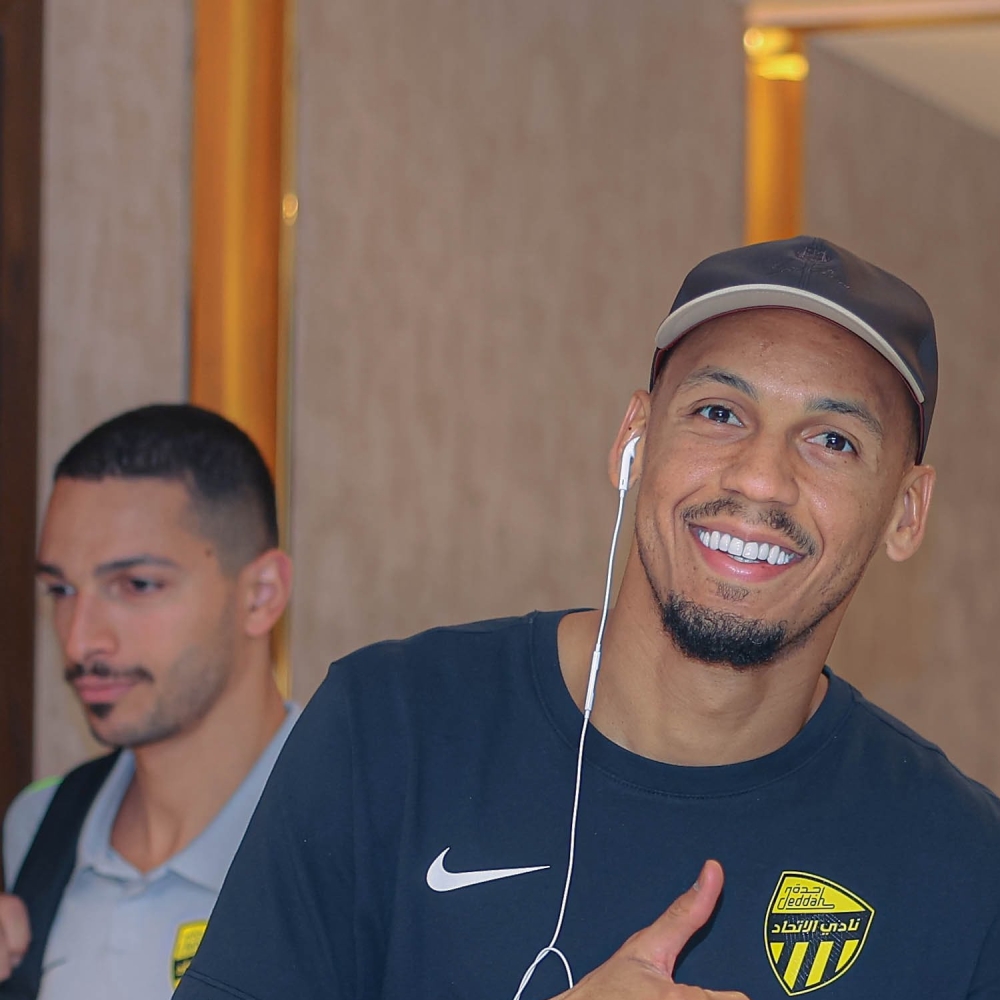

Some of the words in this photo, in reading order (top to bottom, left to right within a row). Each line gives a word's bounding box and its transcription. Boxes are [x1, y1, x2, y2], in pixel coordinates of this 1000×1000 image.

[777, 886, 835, 910] Jeddah
[771, 919, 817, 934] الاتحاد
[820, 918, 861, 936] نادي
